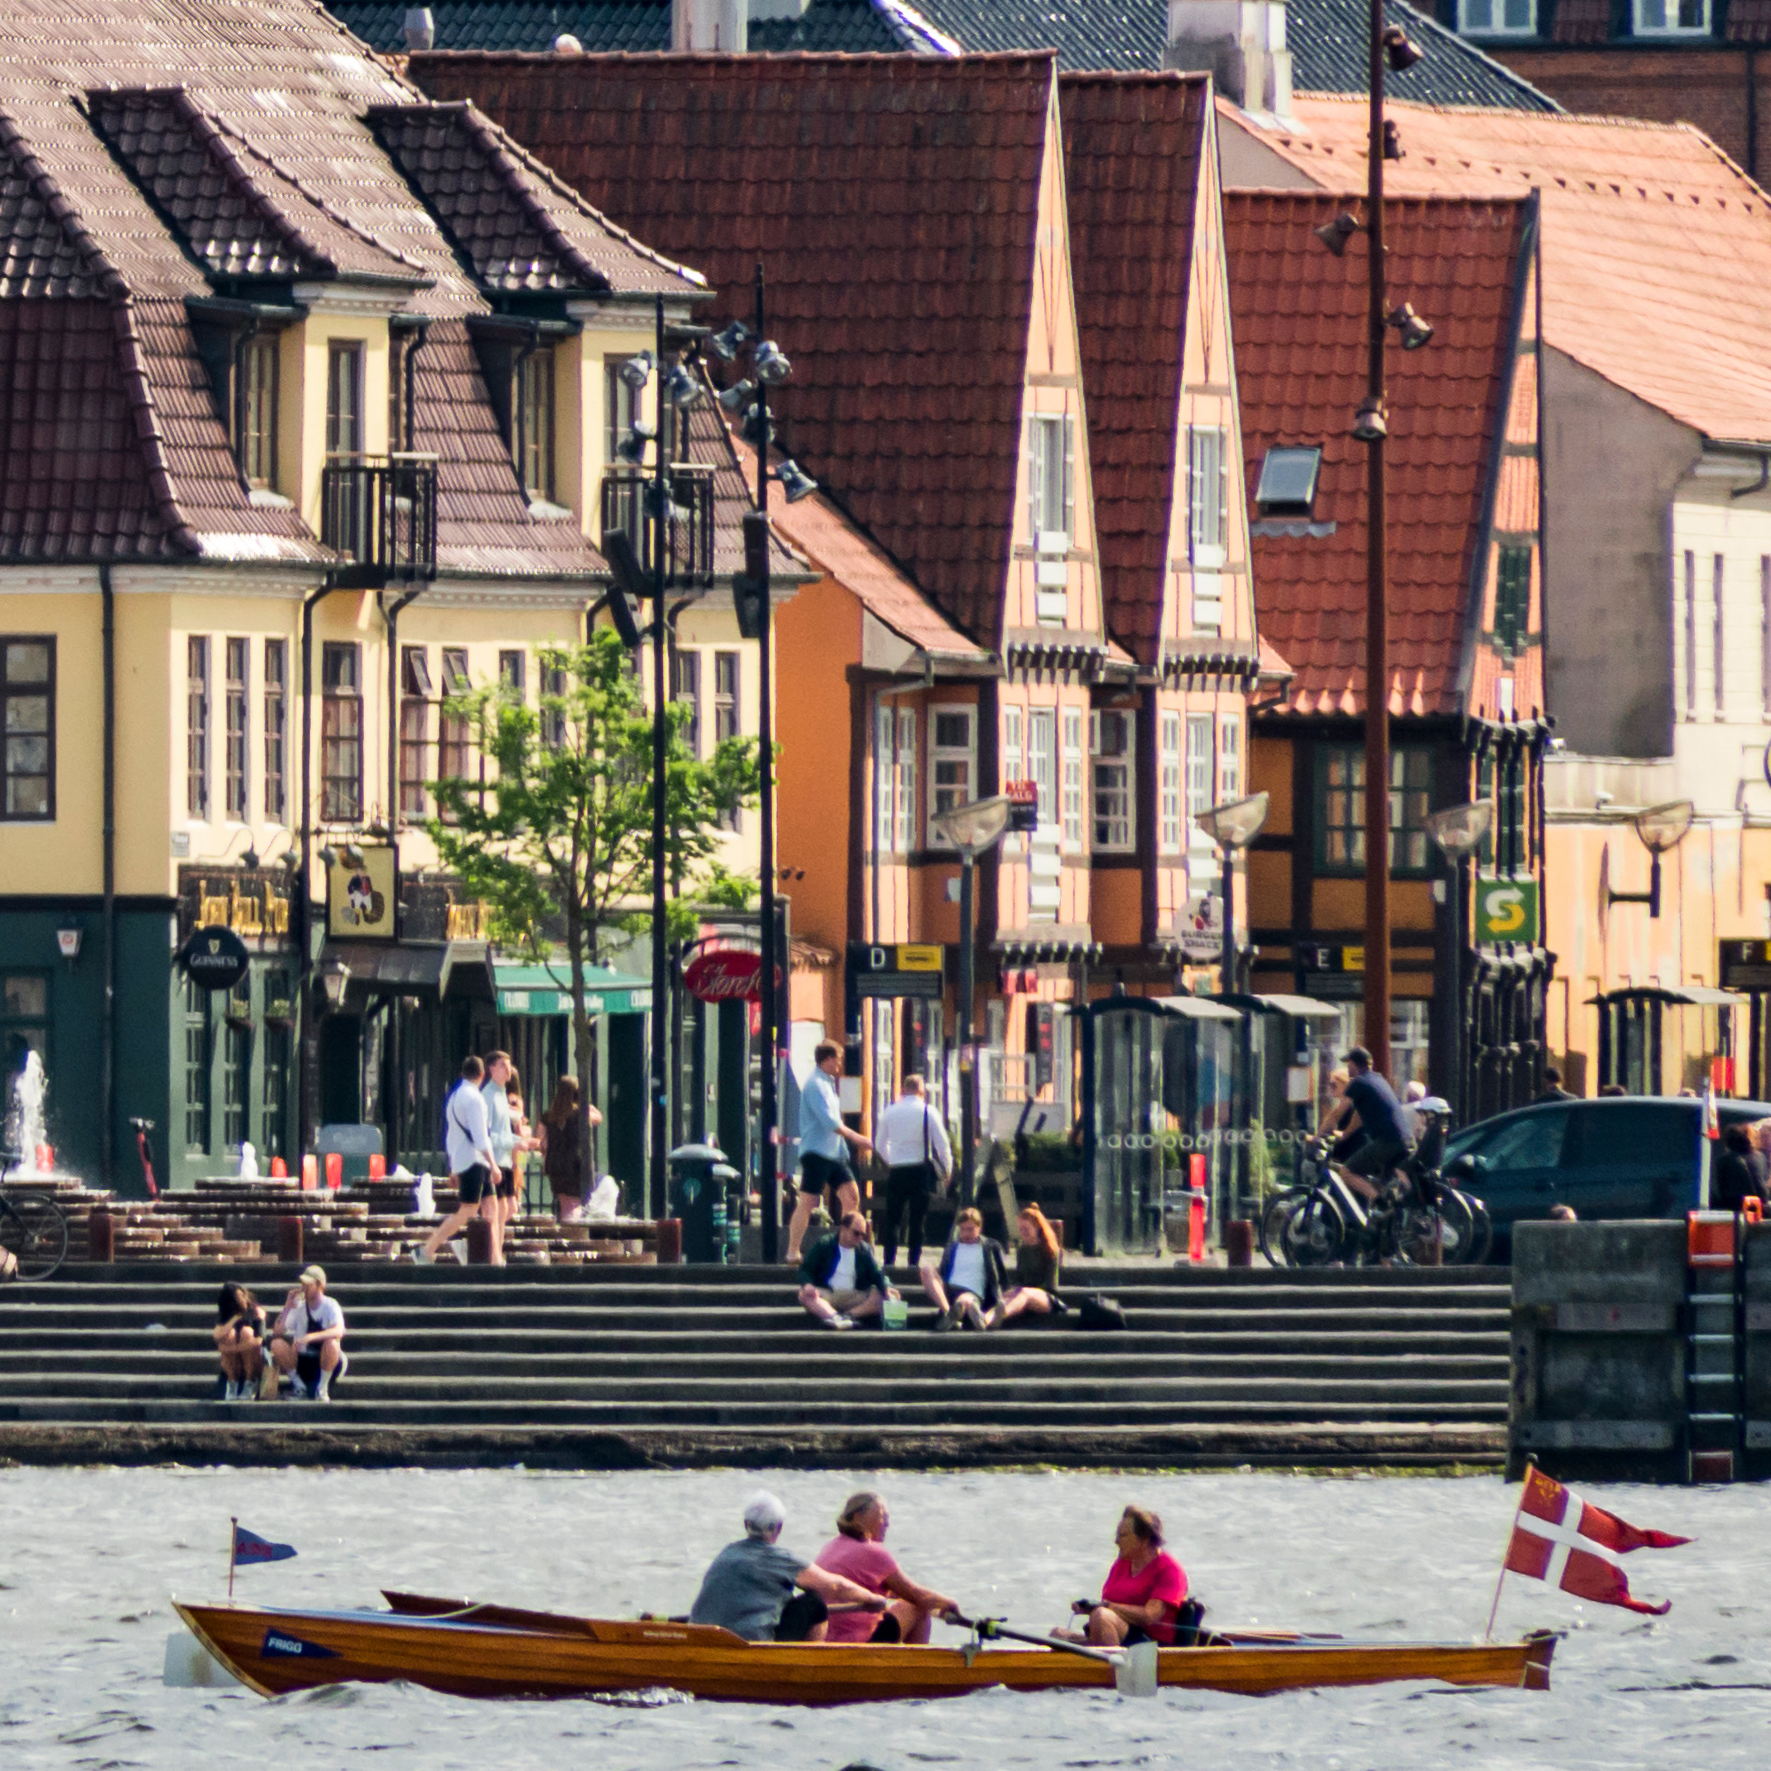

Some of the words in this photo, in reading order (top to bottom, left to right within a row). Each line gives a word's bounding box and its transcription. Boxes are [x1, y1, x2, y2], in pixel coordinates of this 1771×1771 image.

[189, 953, 239, 968] GUINNESS
[871, 947, 886, 970] D
[1317, 948, 1330, 968] E
[1742, 942, 1755, 963] F
